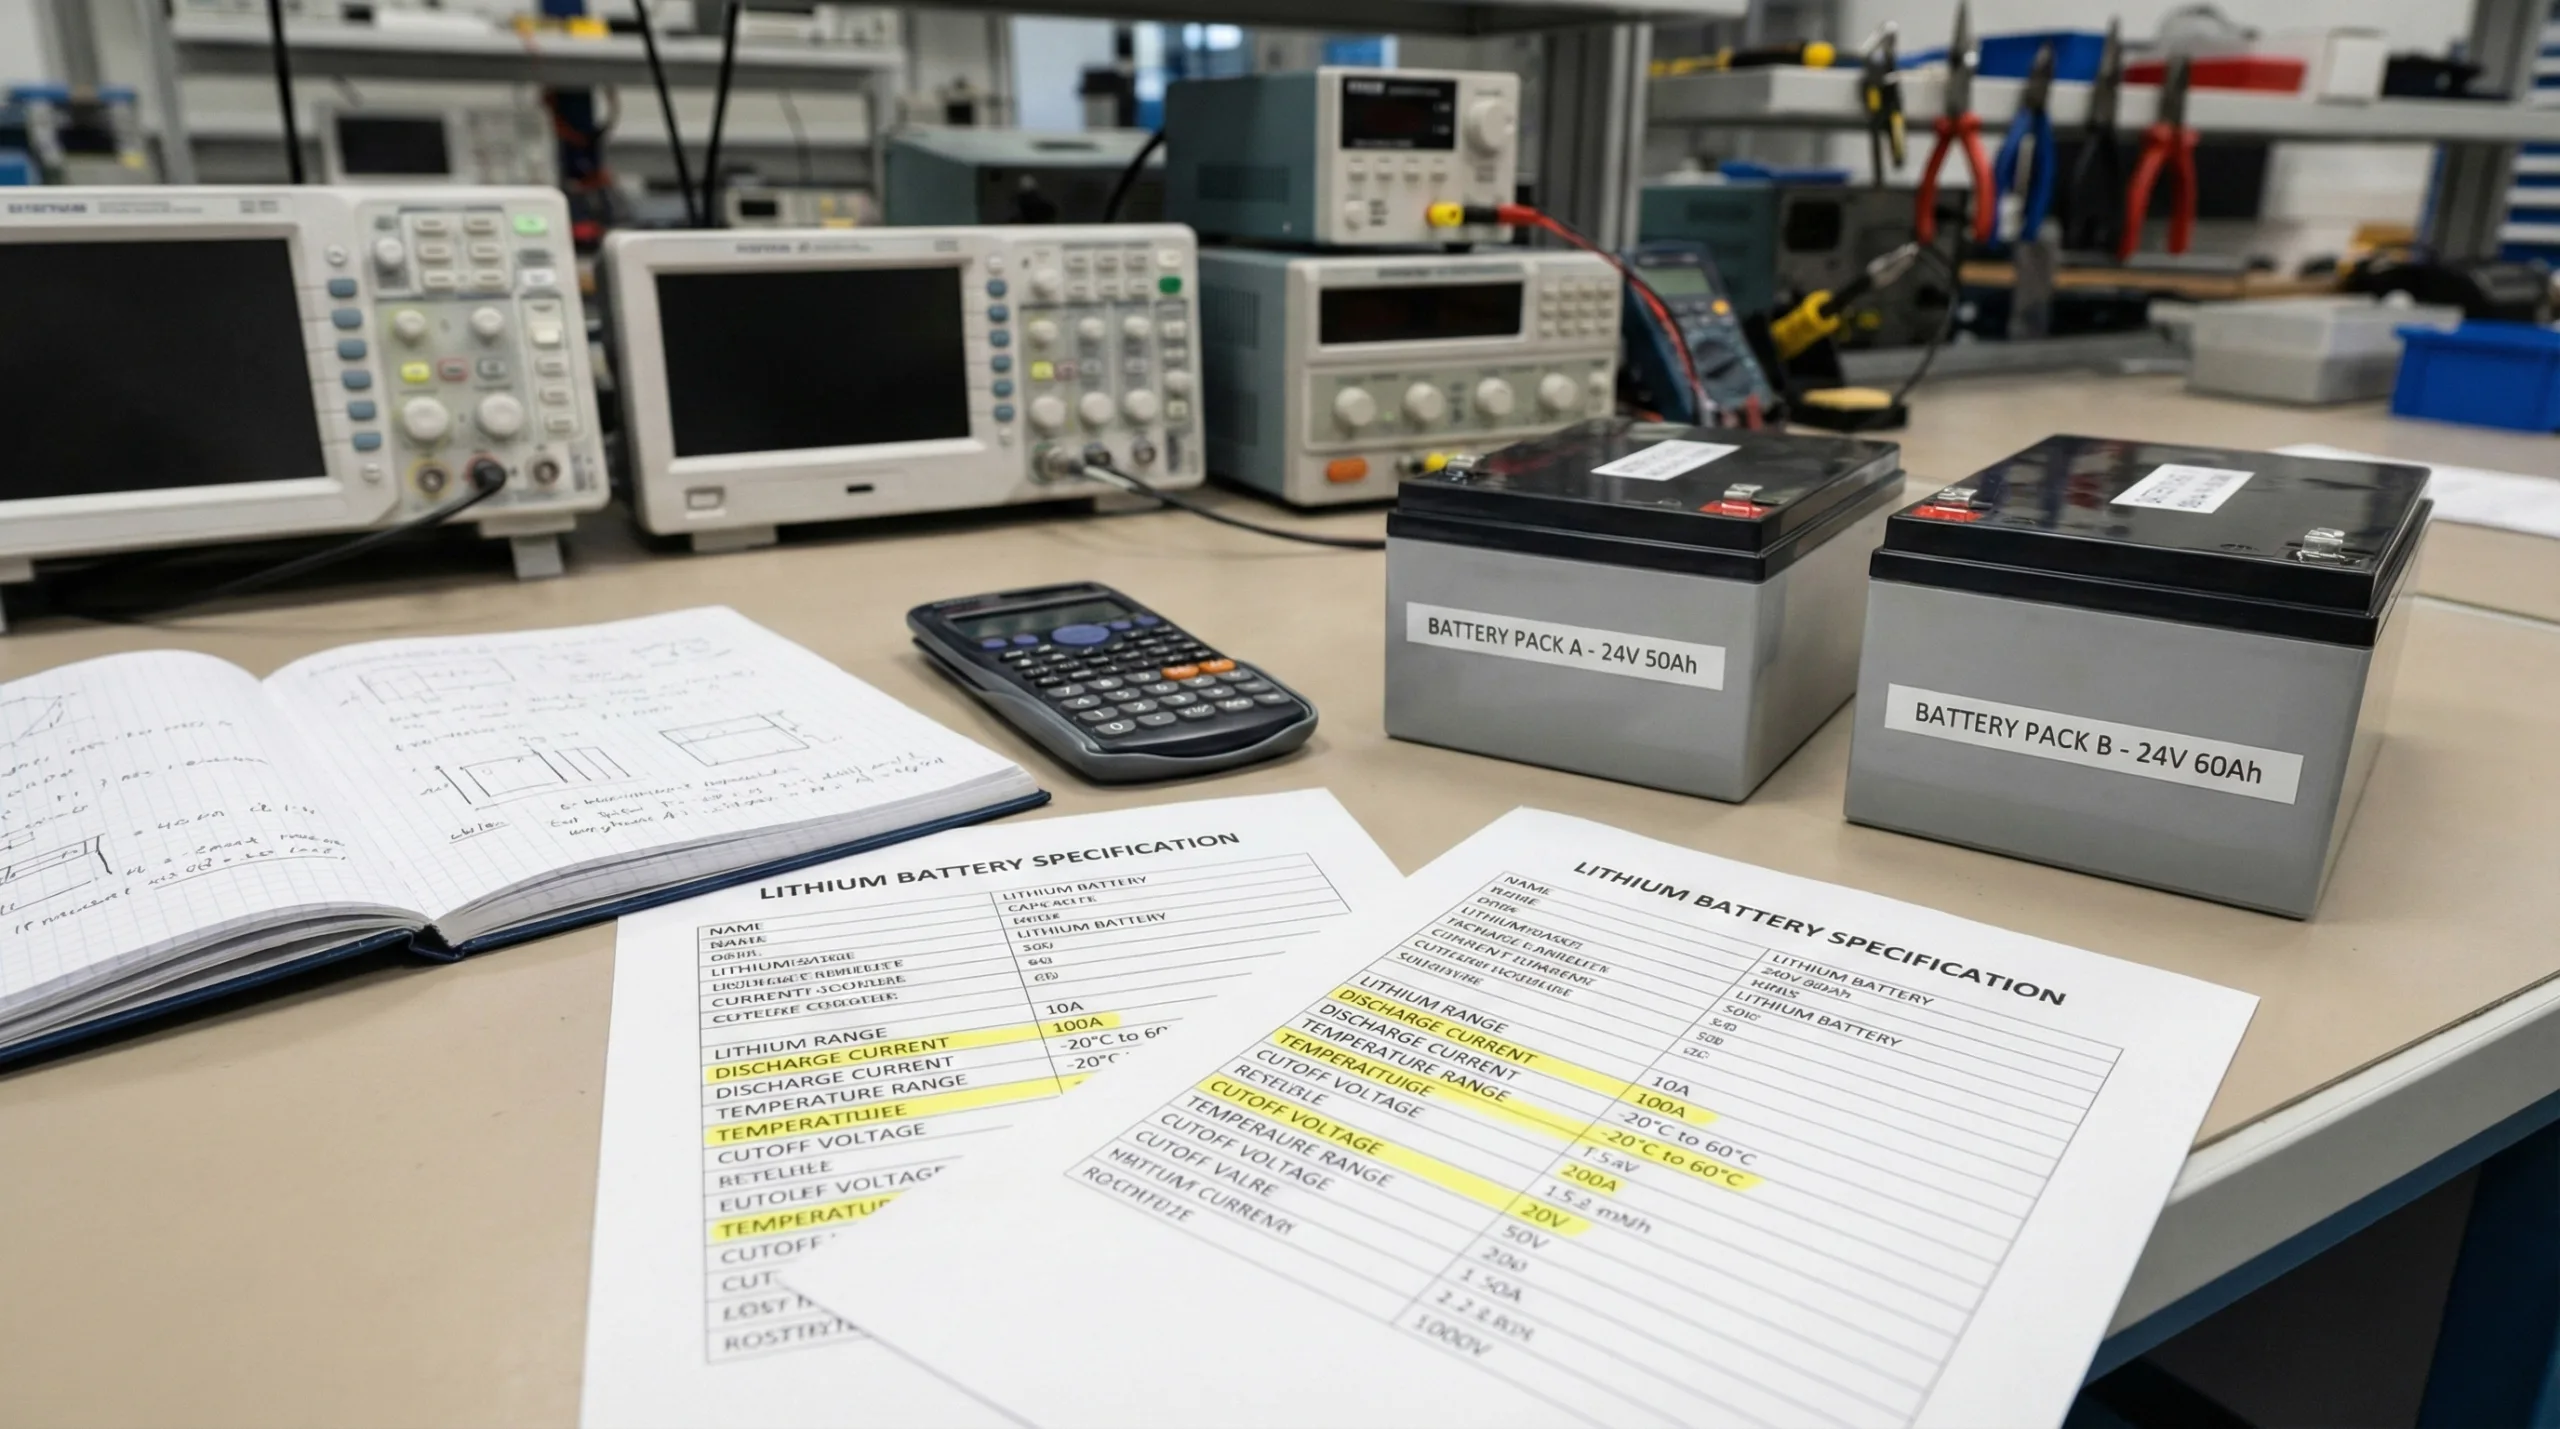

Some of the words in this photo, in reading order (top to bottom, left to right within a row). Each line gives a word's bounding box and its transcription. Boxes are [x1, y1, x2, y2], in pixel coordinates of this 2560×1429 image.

[1428, 617, 1509, 645] BATTERY
[1514, 630, 1564, 655] PACK
[1568, 638, 1583, 657] A
[1601, 643, 1640, 665] 24V
[1645, 650, 1698, 674] 50Ah
[1915, 702, 2019, 738] BATTERY
[2024, 722, 2090, 753] PACK
[2097, 734, 2113, 756] B
[2136, 741, 2188, 769] 24V
[2194, 753, 2263, 784] 60Ah
[760, 873, 888, 900] LITHIUM
[897, 857, 1023, 884] BATTERY
[1033, 832, 1240, 868] SPECIFICATION
[1003, 885, 1073, 901] LITHIUM
[1077, 876, 1147, 892] BATTERY
[1504, 876, 1553, 896] NAME
[1018, 922, 1089, 939] LITHIUM
[1094, 912, 1166, 930] BATTERY
[1572, 861, 1690, 903] LITHIUM
[1694, 893, 1826, 938] BATTERY
[1827, 930, 2068, 1007] SPECIFICATION
[1359, 976, 1440, 1011] LITHIUM
[1441, 1004, 1509, 1034] RANGE
[1772, 954, 1848, 983] LITHIUM
[1851, 977, 1935, 1007] BATTERY
[1046, 1001, 1084, 1015] 10A
[1053, 1017, 1104, 1033] 100A
[1338, 989, 1444, 1032] DISCHARGE
[1445, 1027, 1538, 1064] CURRENT
[1735, 991, 1814, 1021] LITHIUM
[1817, 1015, 1903, 1047] BATTERY
[714, 1038, 807, 1060] LITHIUM
[814, 1027, 888, 1047] RANGE
[715, 1052, 841, 1080] DISCHARGE
[848, 1037, 950, 1061] CURRENT
[1060, 1034, 1114, 1051] -20°C
[1118, 1032, 1139, 1043] to
[1302, 1018, 1440, 1075] TEMPERATURE
[1440, 1070, 1512, 1103] RANGE
[1319, 1003, 1427, 1049] DISCHARGE
[1427, 1043, 1522, 1081] CURRENT
[716, 1071, 844, 1099] DISCHARGE
[851, 1056, 955, 1080] CURRENT
[716, 1086, 885, 1120] TEMPERATURE
[892, 1073, 969, 1095] RANGE
[1256, 1049, 1333, 1082] CUTOFF
[1334, 1077, 1425, 1119] VOLTAGE
[1652, 1076, 1690, 1097] 10A
[1211, 1080, 1289, 1115] CUTOFF
[1290, 1110, 1385, 1155] VOLTAGE
[1636, 1093, 1685, 1119] 100A
[717, 1139, 812, 1164] CUTOFF
[817, 1122, 927, 1149] VOLTAGE
[1135, 1130, 1213, 1167] CUTOFF
[1214, 1162, 1279, 1198] VALRE
[1161, 1112, 1239, 1149] CUTOFF
[1240, 1144, 1335, 1192] VOLTAGE
[1186, 1095, 1320, 1157] TEMPERAURE
[1319, 1150, 1395, 1188] RANGE
[1601, 1129, 1660, 1157] -20°C
[1663, 1150, 1685, 1165] to
[1689, 1160, 1744, 1187] 60°C
[1618, 1111, 1675, 1137] -20°C
[1678, 1131, 1699, 1147] to
[1705, 1140, 1758, 1167] 60°C
[1561, 1164, 1617, 1193] 200A
[1502, 1224, 1551, 1249] 50V
[1520, 1203, 1571, 1229] 20V
[721, 1235, 823, 1264] CUTOFF
